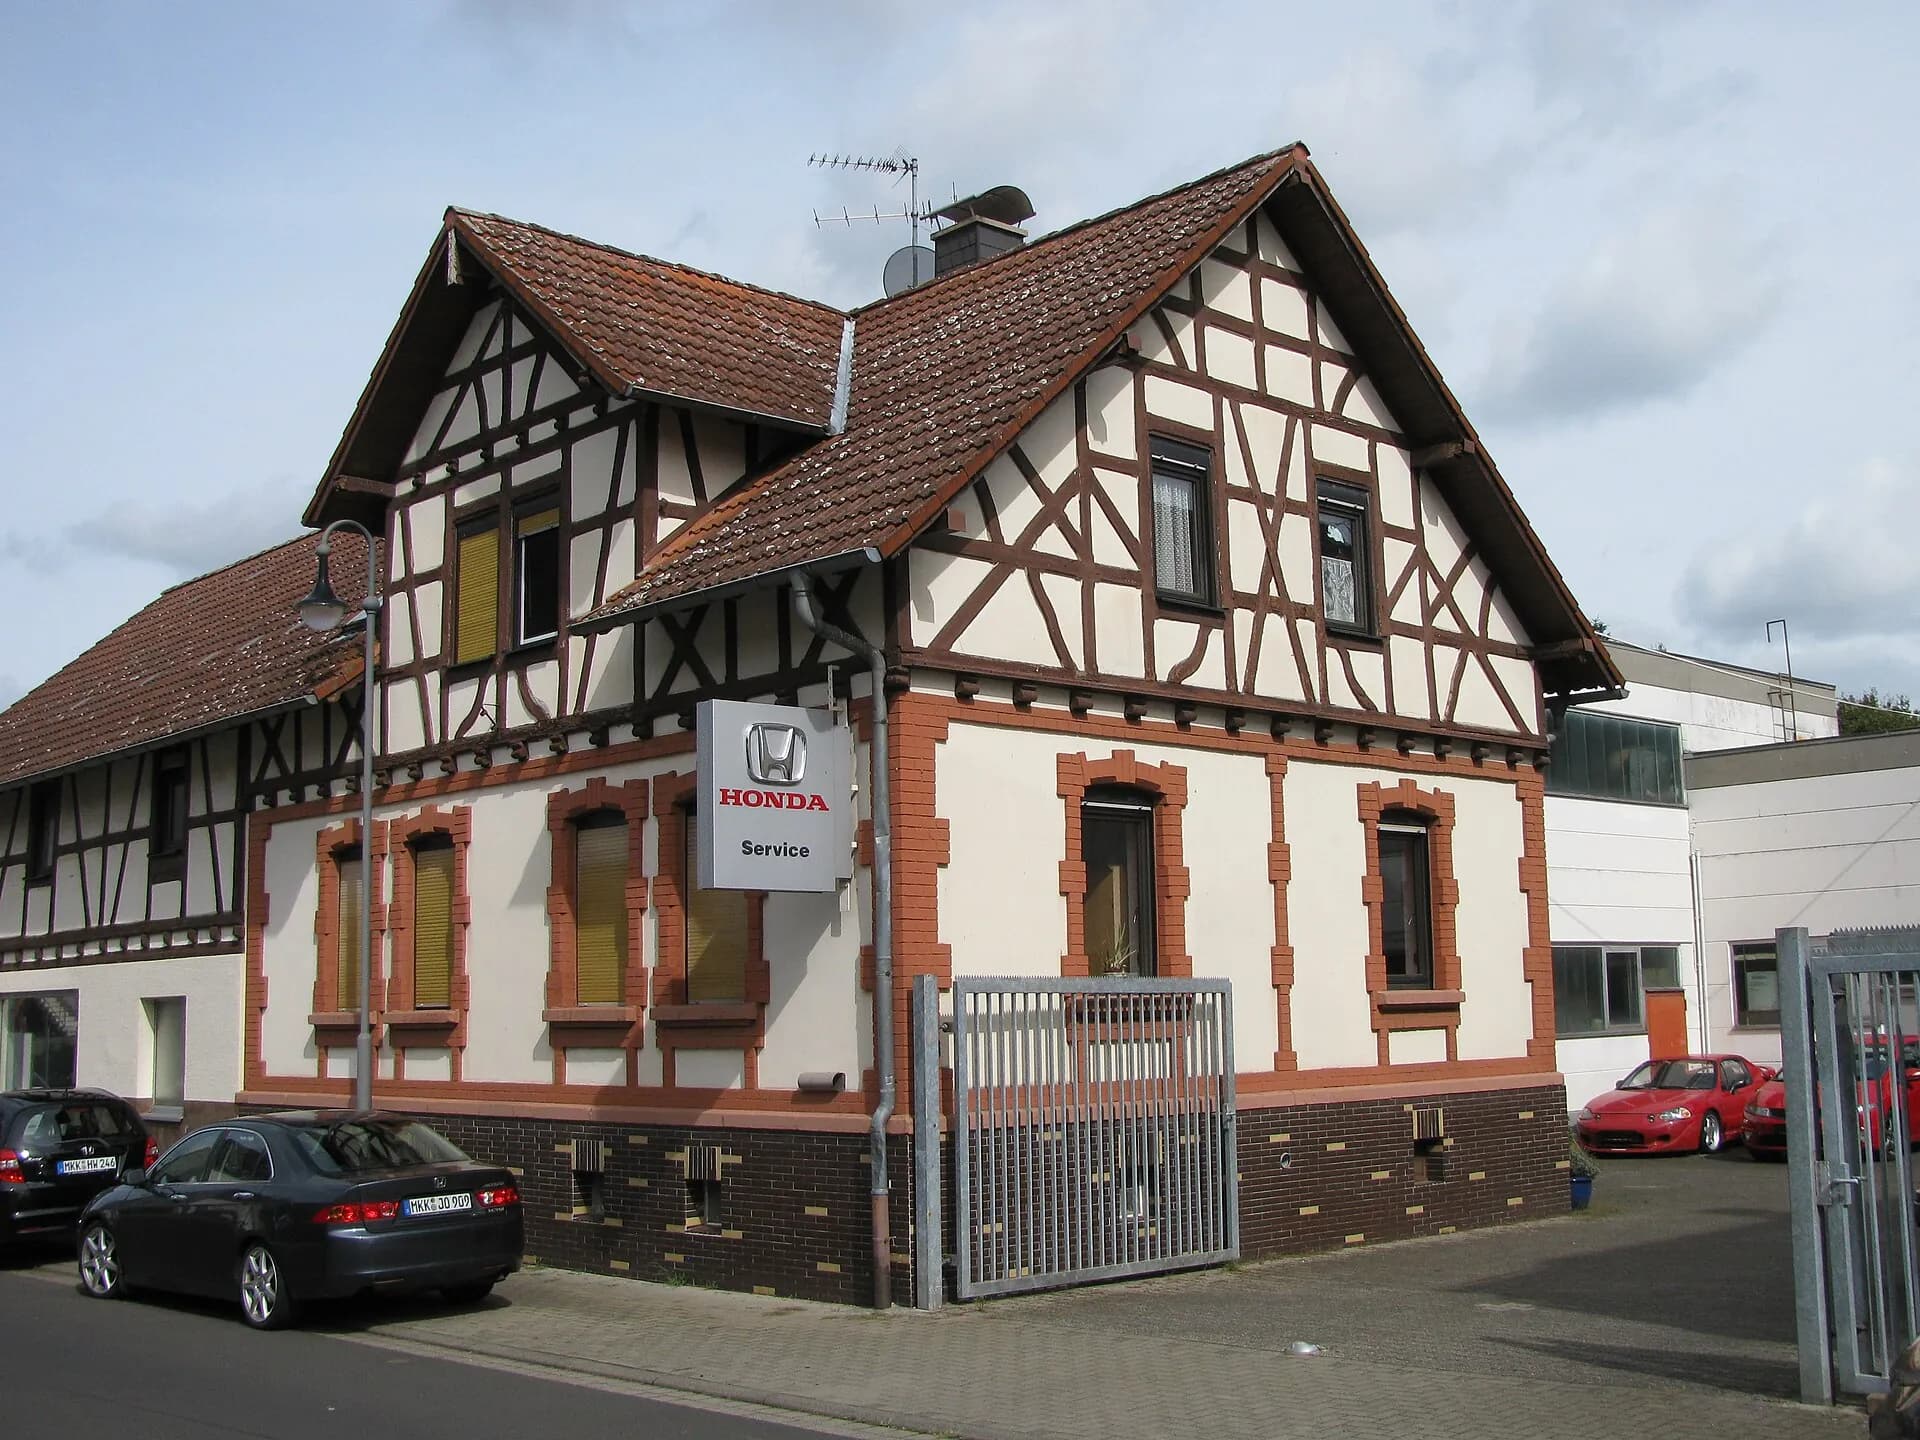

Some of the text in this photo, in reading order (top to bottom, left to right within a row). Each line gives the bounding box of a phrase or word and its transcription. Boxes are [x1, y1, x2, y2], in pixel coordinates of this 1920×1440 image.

[719, 788, 829, 812] HONDA
[741, 839, 810, 858] Service
[64, 1161, 81, 1171] MKK
[100, 1158, 115, 1168] 246
[411, 1200, 431, 1213] MKK
[452, 1194, 470, 1208] 909
